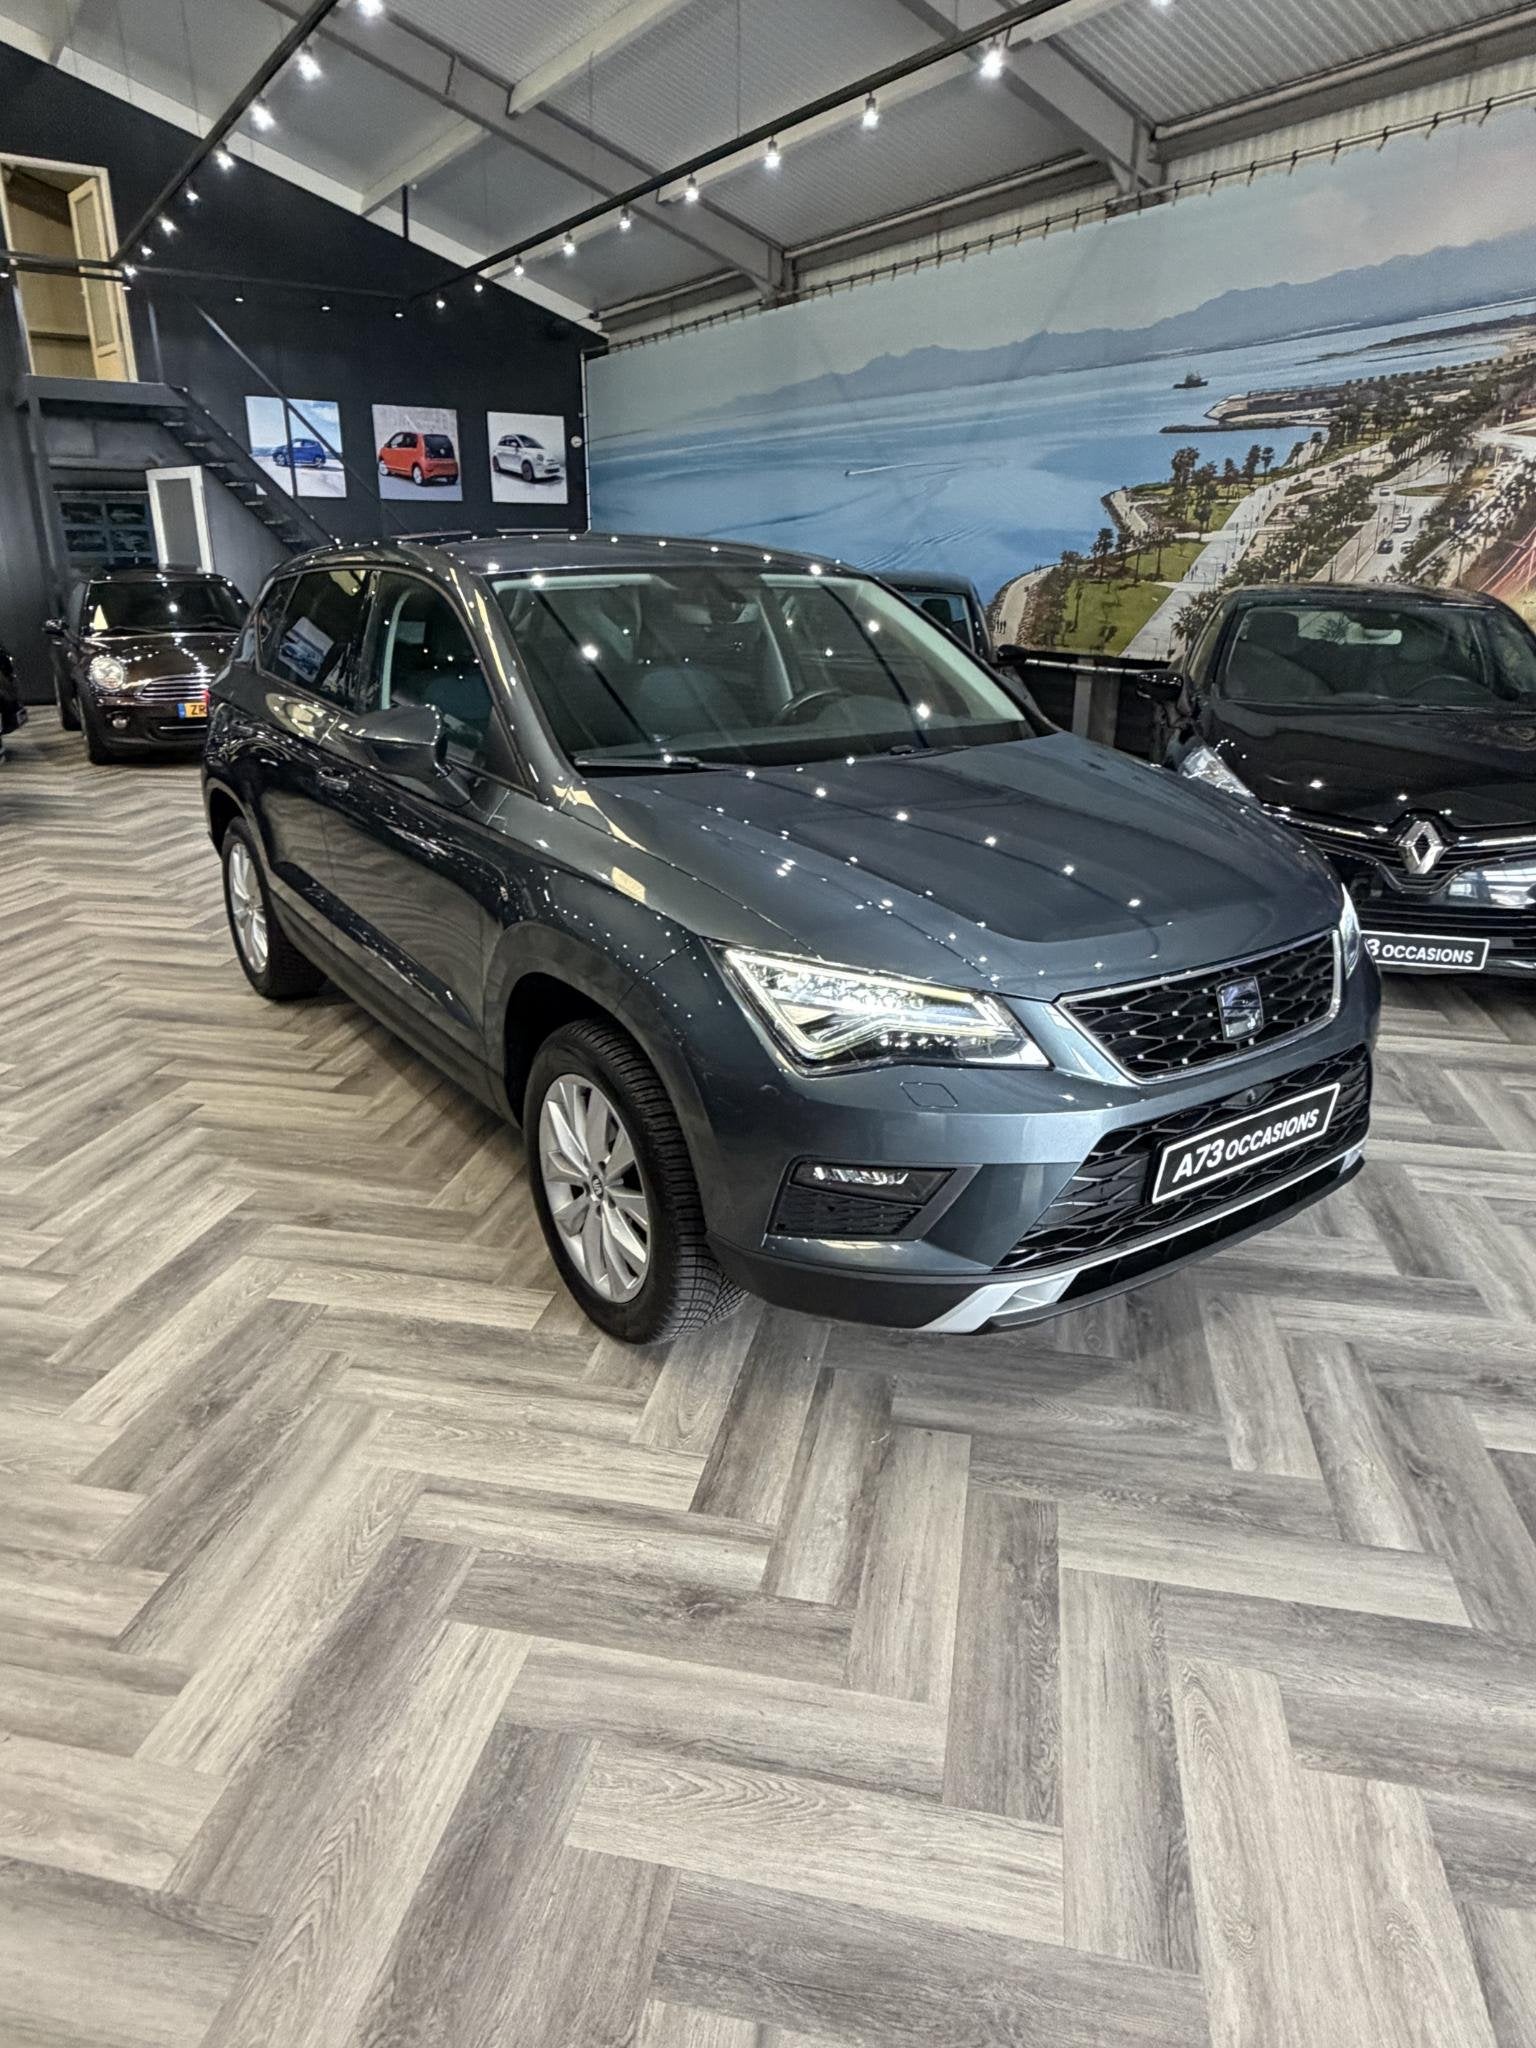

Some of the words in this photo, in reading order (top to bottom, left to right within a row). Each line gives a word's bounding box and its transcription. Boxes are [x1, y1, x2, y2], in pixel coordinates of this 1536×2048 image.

[1367, 939, 1380, 956] 3
[1382, 944, 1474, 963] OCCASIONS
[1172, 1139, 1225, 1183] A73
[1225, 1109, 1319, 1161] OCCASIONS
